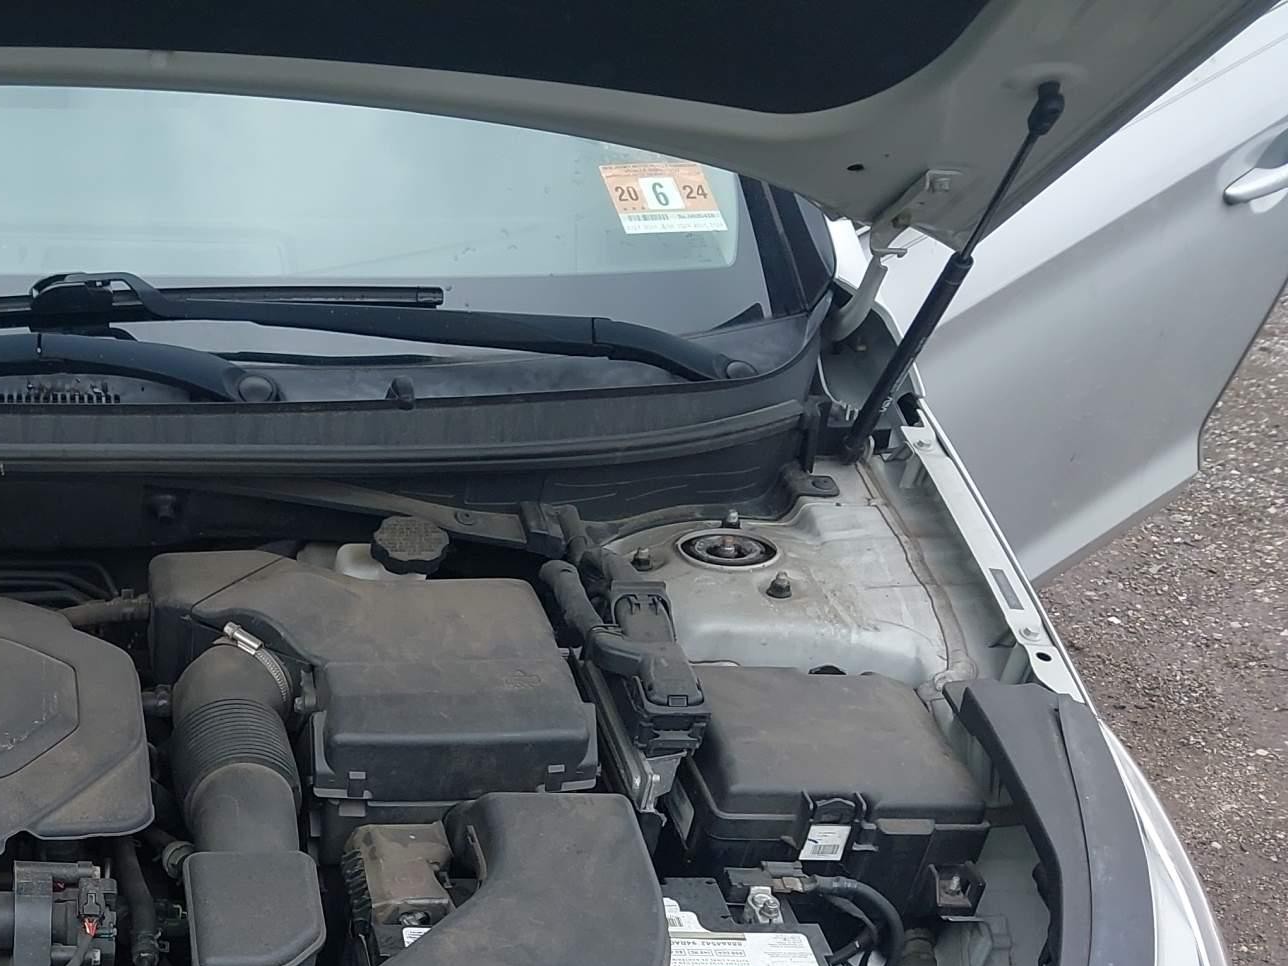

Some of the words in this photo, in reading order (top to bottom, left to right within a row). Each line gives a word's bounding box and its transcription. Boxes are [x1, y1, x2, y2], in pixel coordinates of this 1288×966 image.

[615, 186, 639, 201] 20
[652, 182, 669, 206] 6
[682, 184, 708, 200] 24
